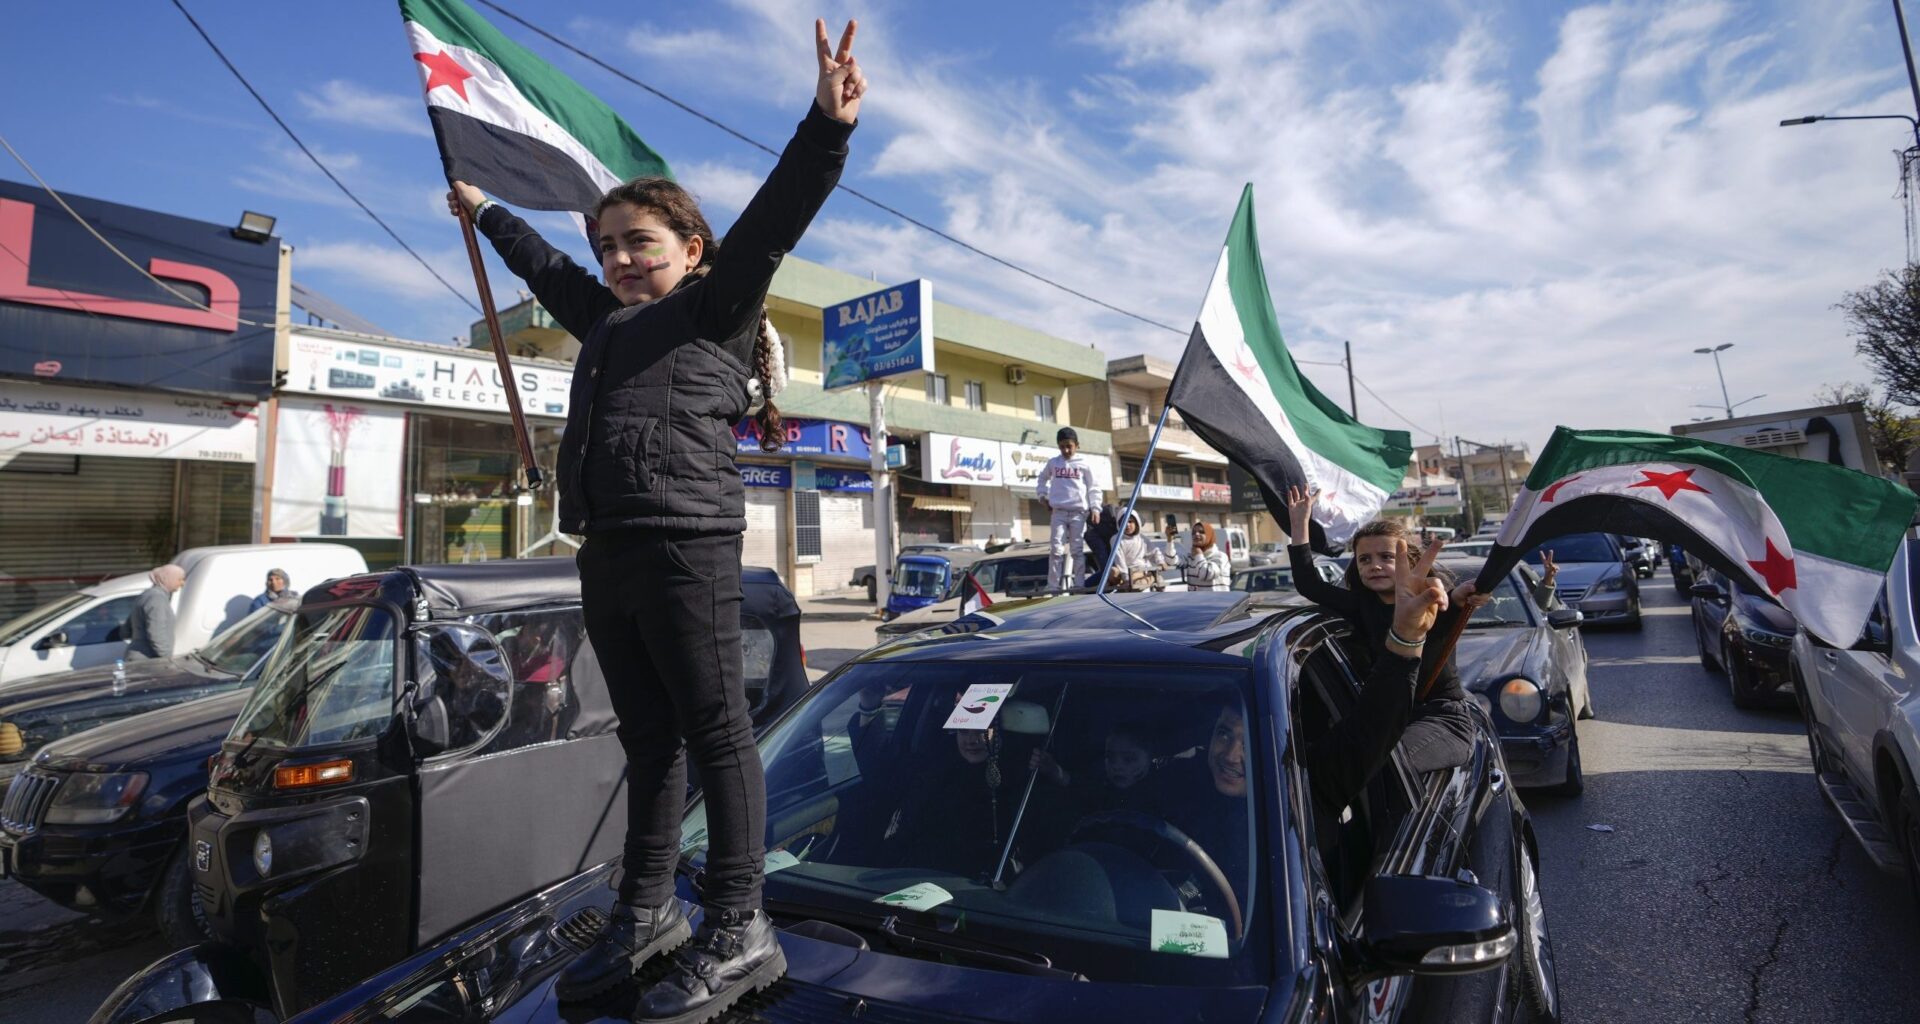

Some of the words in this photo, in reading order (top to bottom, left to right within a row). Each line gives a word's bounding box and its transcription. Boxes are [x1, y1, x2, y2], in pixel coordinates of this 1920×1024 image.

[838, 290, 904, 327] RAJAB
[432, 387, 537, 407] ELECTIC
[31, 426, 84, 447] إيمان
[95, 426, 169, 448] الأستاذة
[740, 468, 781, 484] GREE
